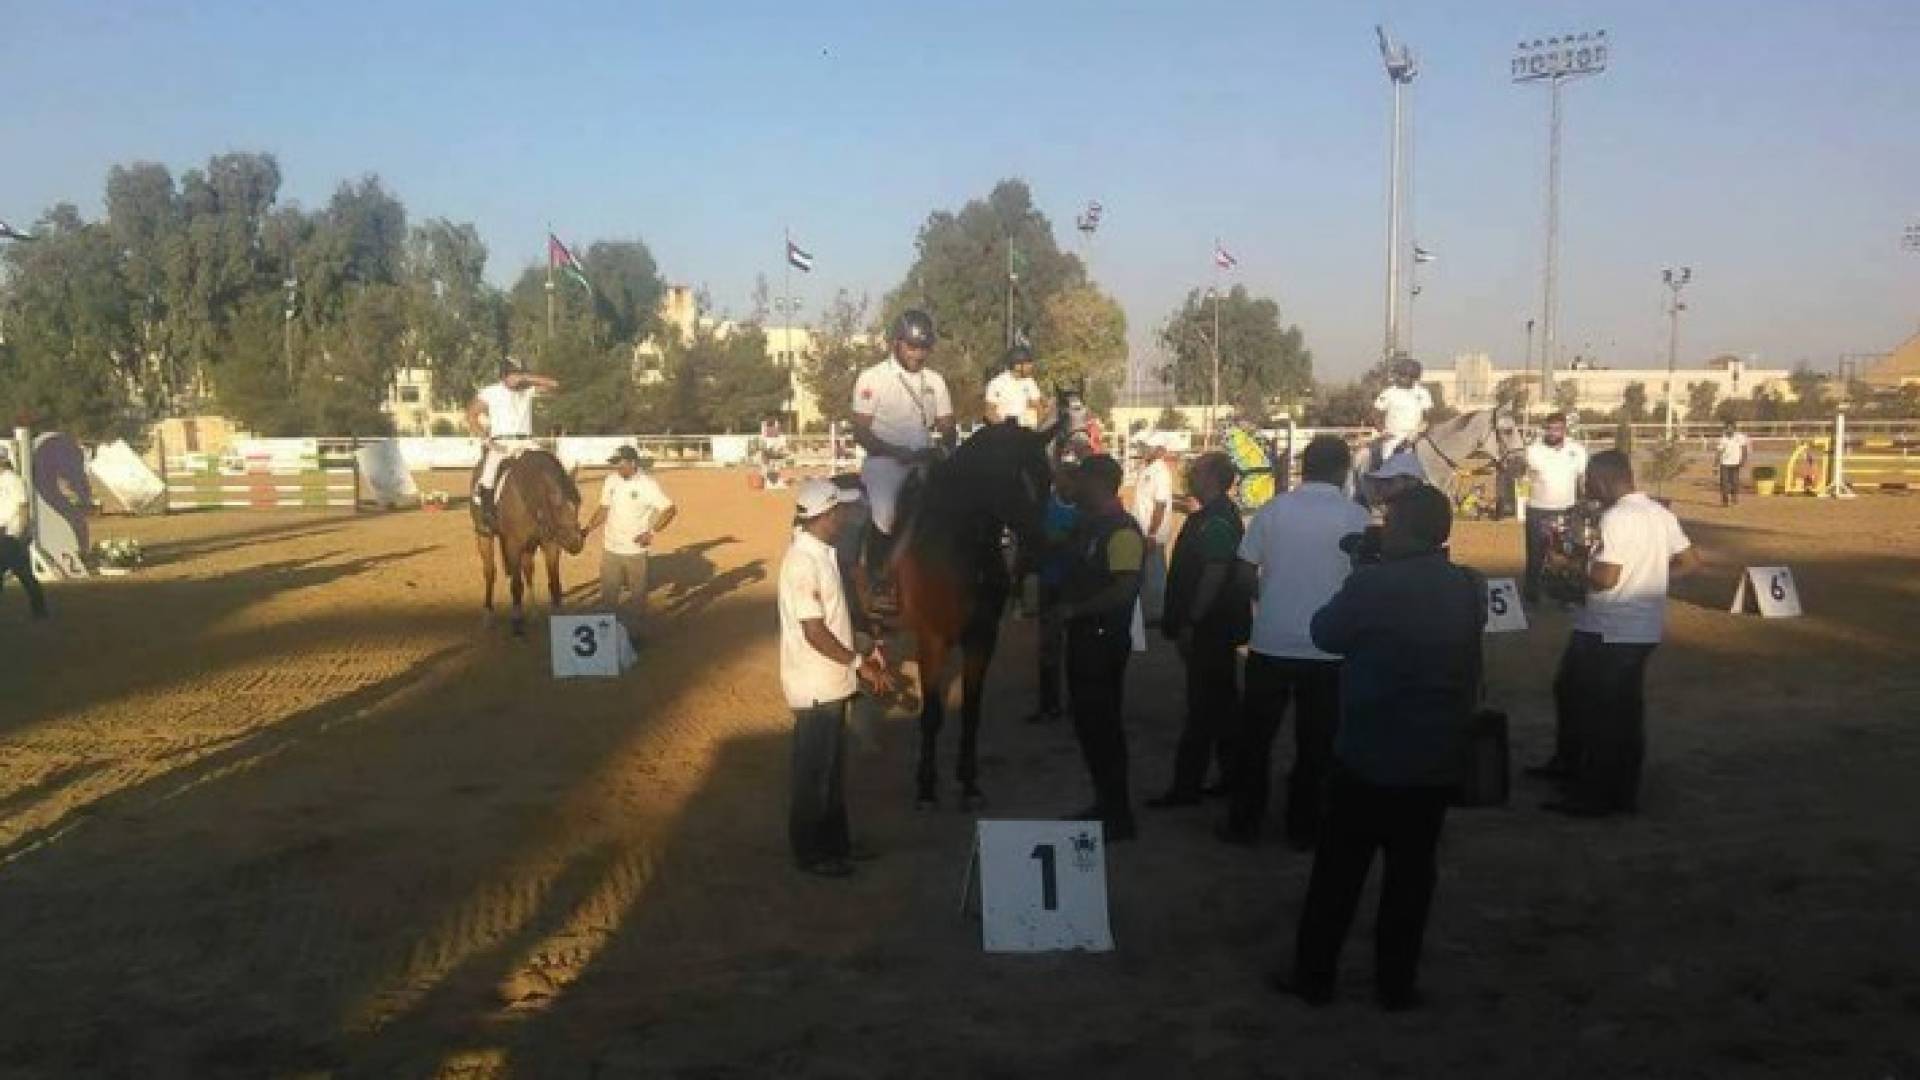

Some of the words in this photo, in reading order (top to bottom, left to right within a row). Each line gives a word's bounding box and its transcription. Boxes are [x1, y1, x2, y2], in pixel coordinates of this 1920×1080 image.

[1490, 588, 1507, 615] 5
[1771, 574, 1786, 601] 6
[573, 625, 598, 657] 3
[1030, 843, 1057, 911] 1
